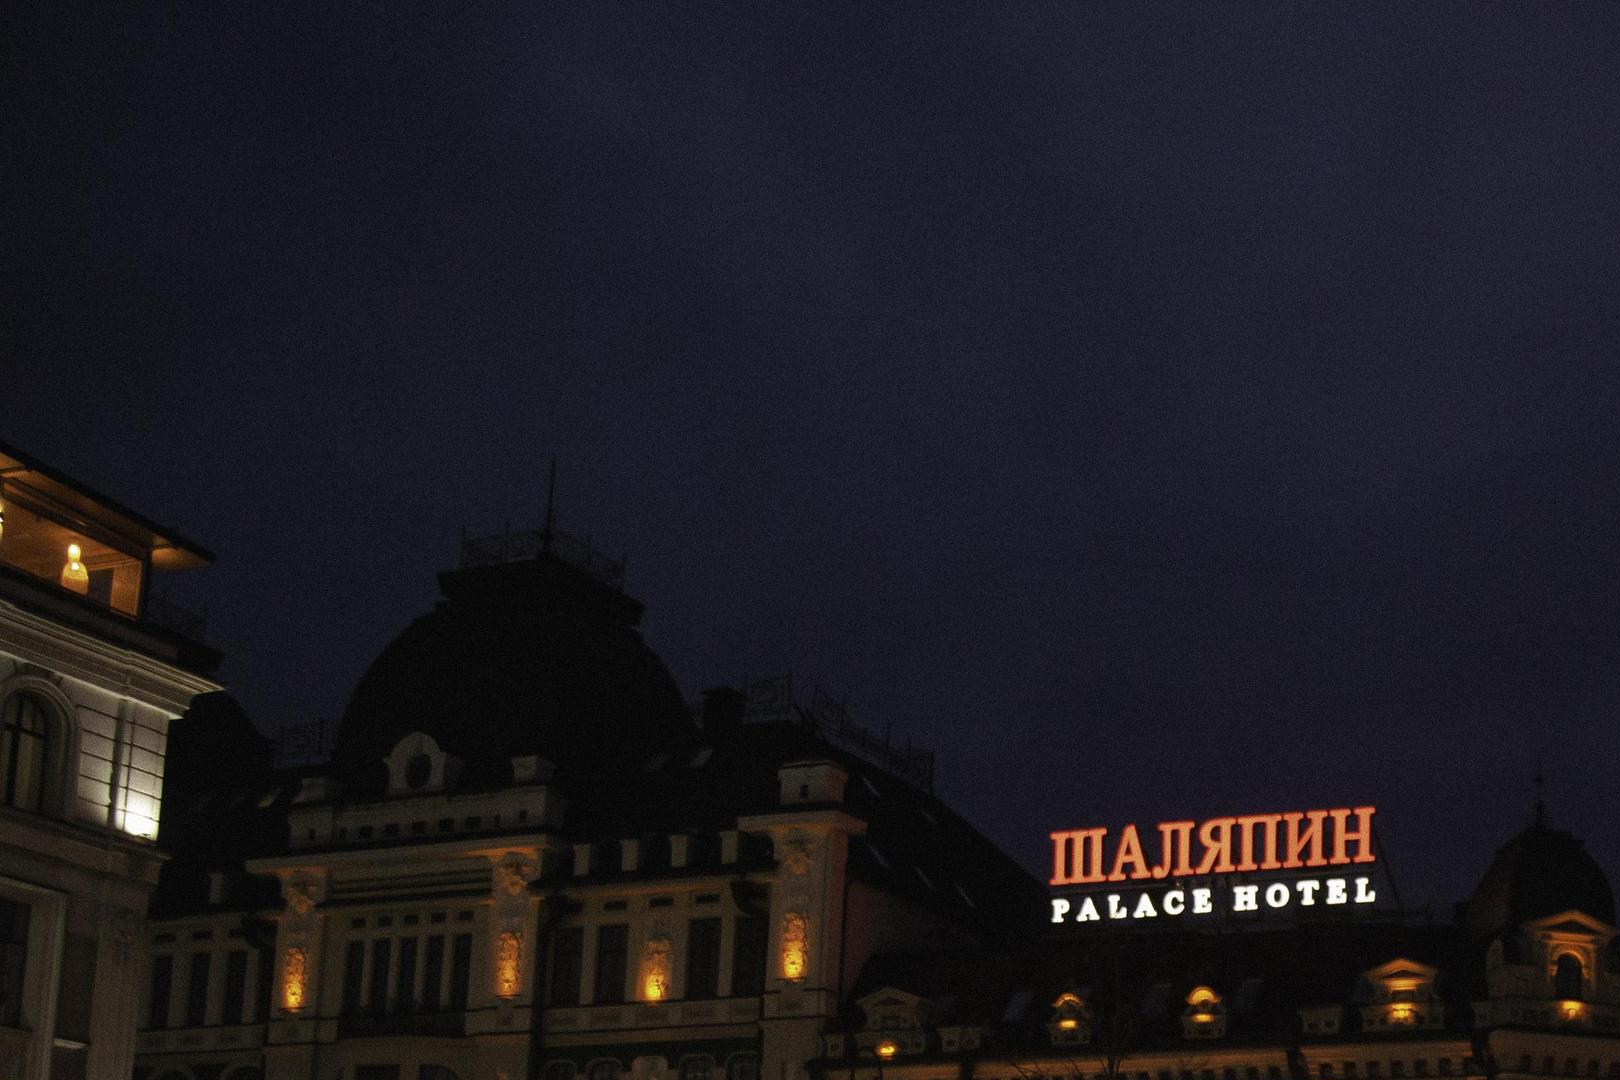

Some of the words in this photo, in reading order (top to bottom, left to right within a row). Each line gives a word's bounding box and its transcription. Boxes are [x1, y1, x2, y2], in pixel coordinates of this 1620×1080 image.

[1049, 806, 1375, 885] ШАЛЯПИН
[1051, 887, 1212, 923] PALACE
[1233, 877, 1376, 911] HOTEL
